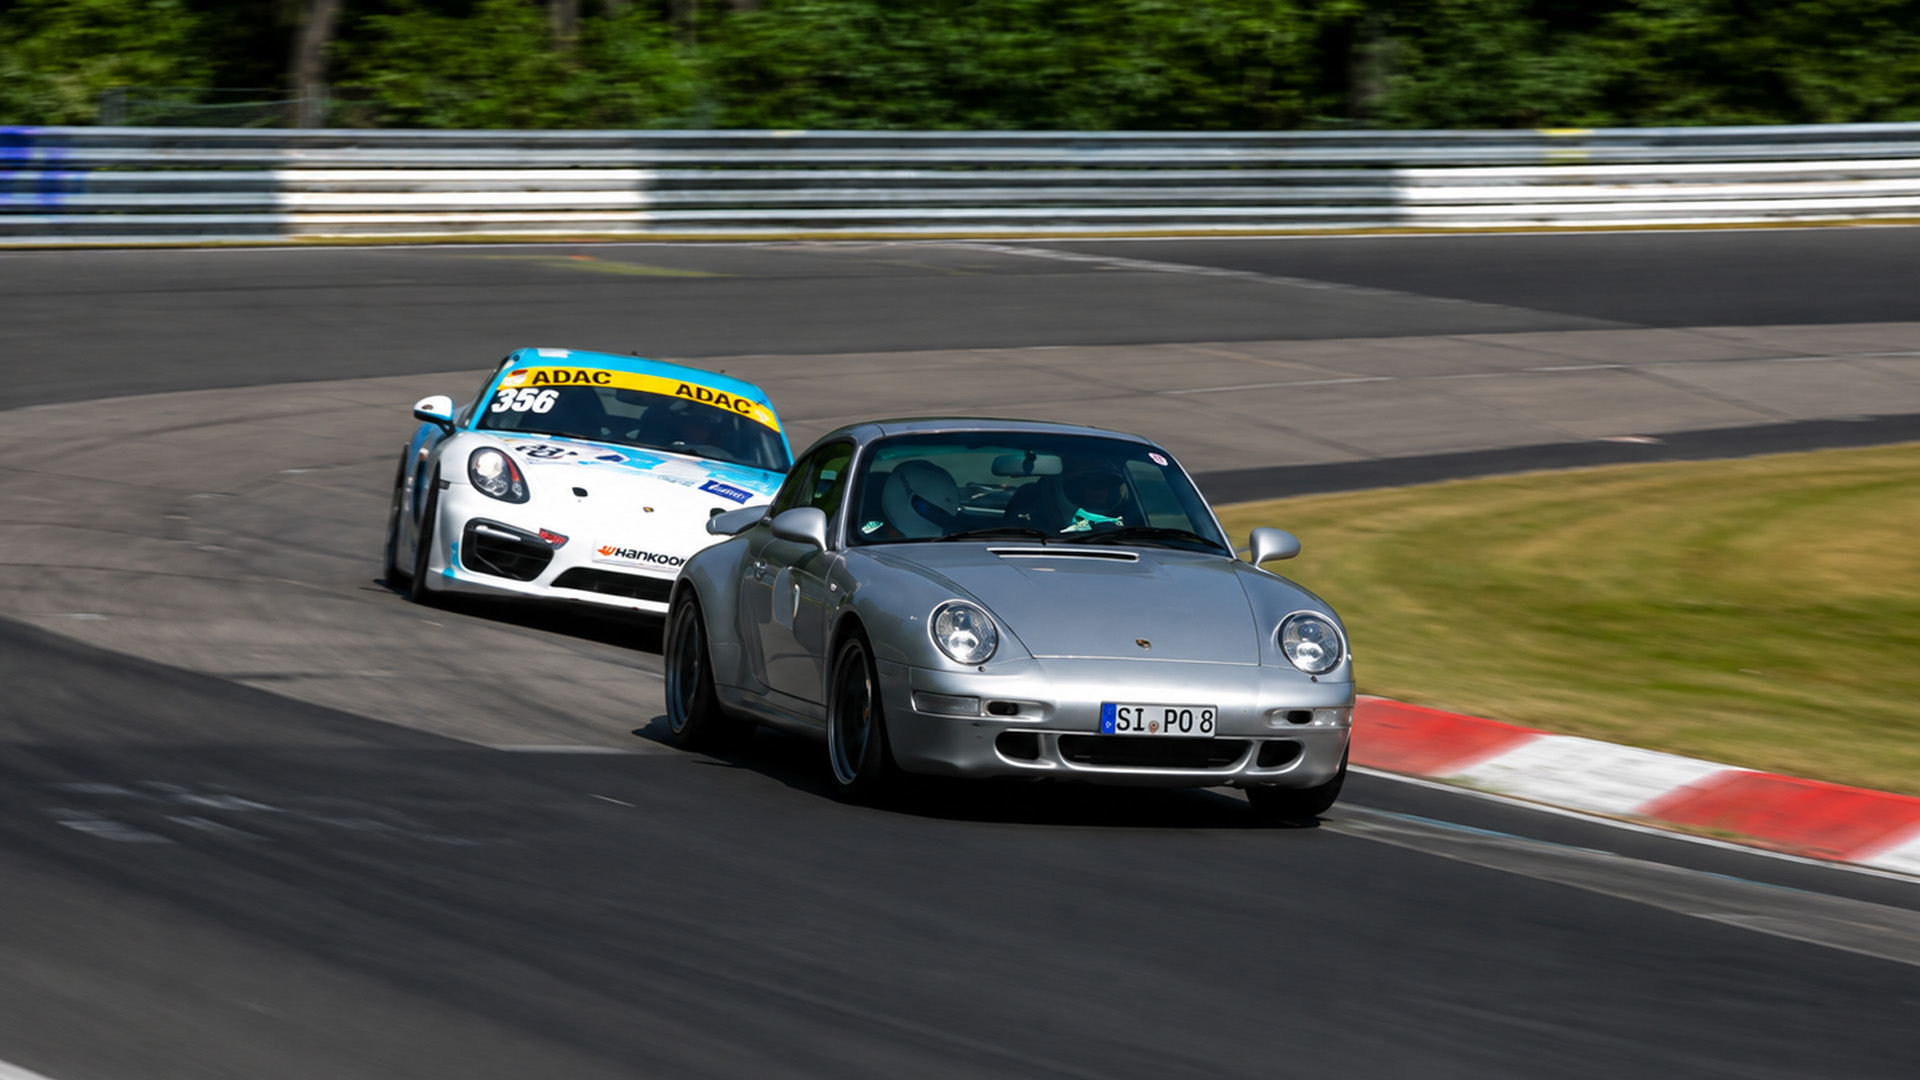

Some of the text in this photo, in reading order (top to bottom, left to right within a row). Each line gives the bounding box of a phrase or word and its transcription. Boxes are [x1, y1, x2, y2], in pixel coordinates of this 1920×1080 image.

[532, 369, 612, 386] ADAC
[491, 388, 560, 414] 356
[675, 383, 752, 415] ADAC
[1116, 707, 1213, 733] SI PO 8
